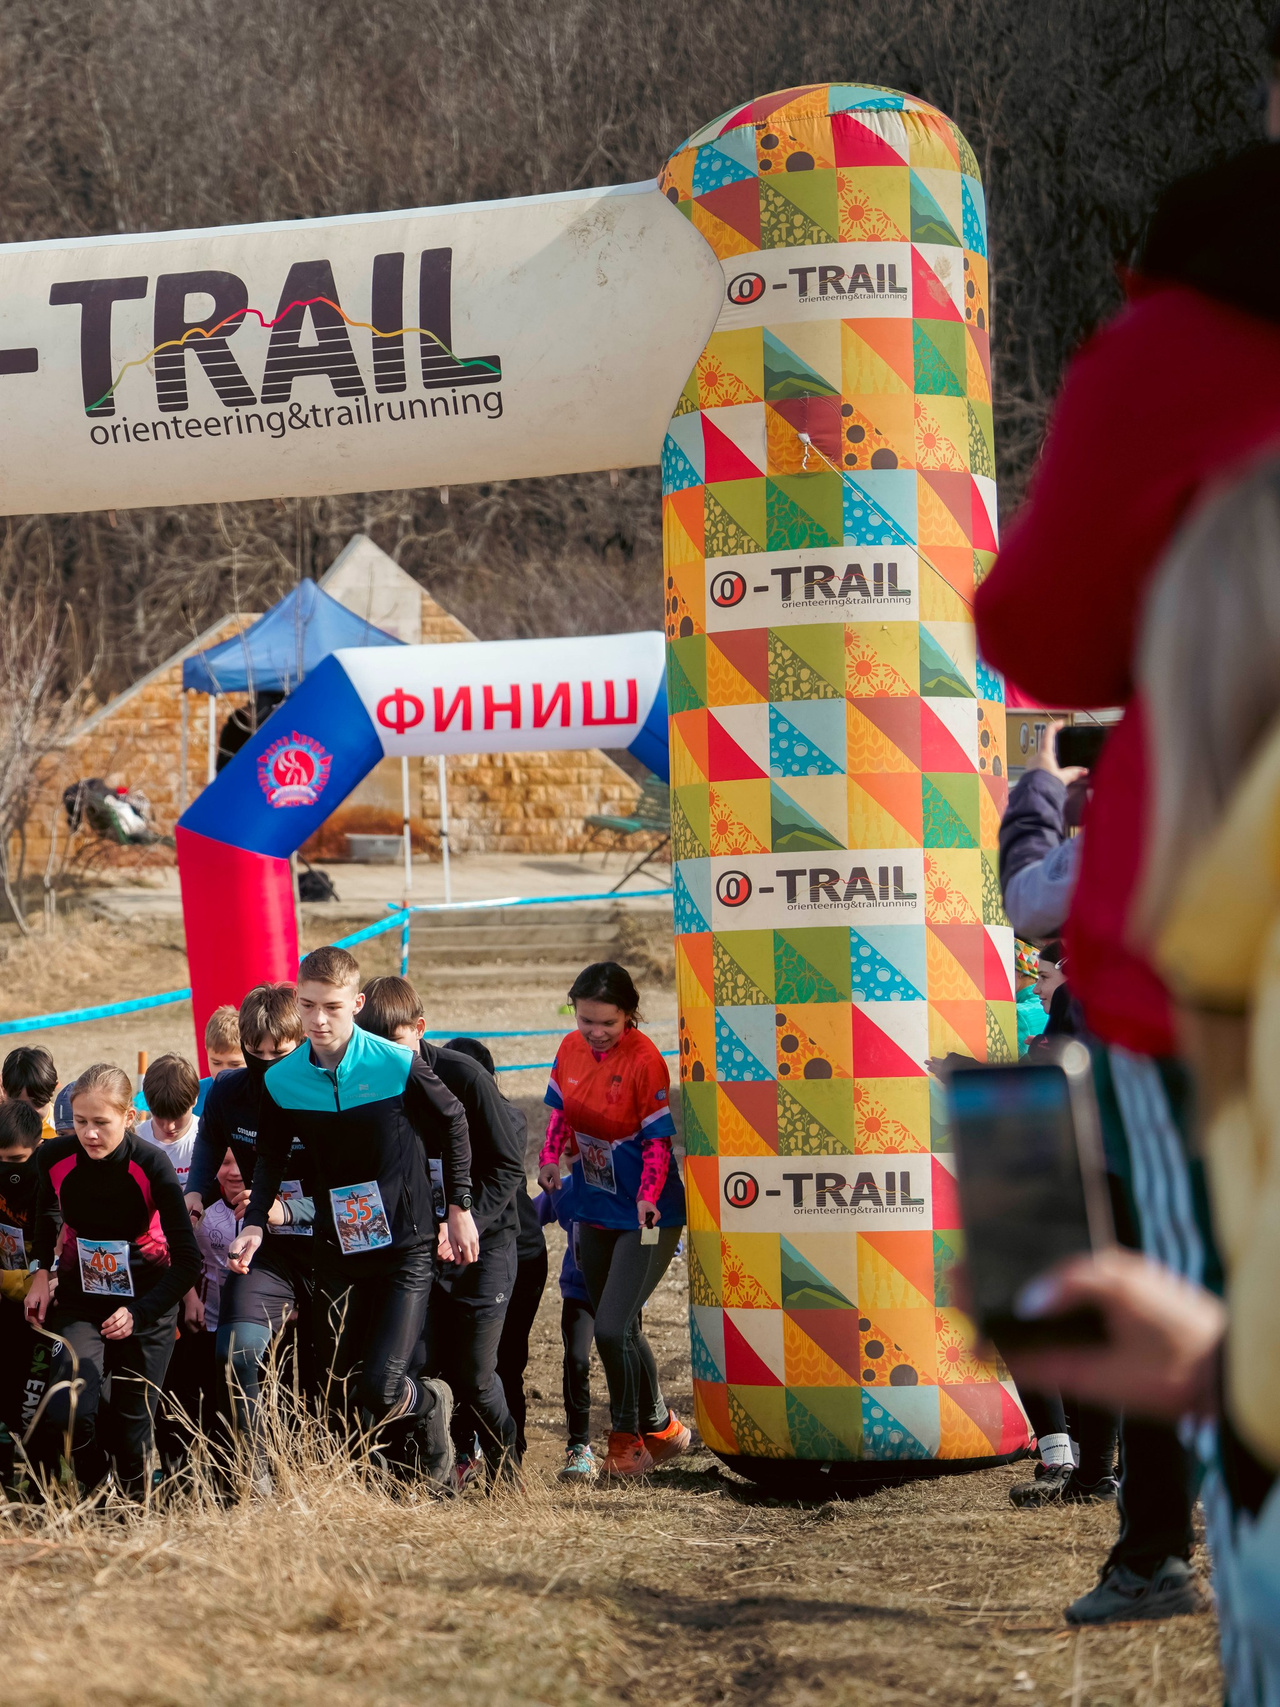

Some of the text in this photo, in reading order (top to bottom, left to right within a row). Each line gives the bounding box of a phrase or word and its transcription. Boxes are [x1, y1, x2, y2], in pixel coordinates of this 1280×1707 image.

[798, 292, 908, 303] orienteering&trailrunning
[90, 386, 504, 447] orienteering&trailrunning
[781, 595, 912, 609] orienteering&trailrunning
[376, 678, 638, 734] ФИНИШ
[787, 899, 917, 911] orienteering&trailrunning
[587, 1145, 607, 1169] 46
[345, 1198, 373, 1225] 55
[793, 1204, 925, 1216] orienteering&trailrunning
[90, 1251, 118, 1274] 40
